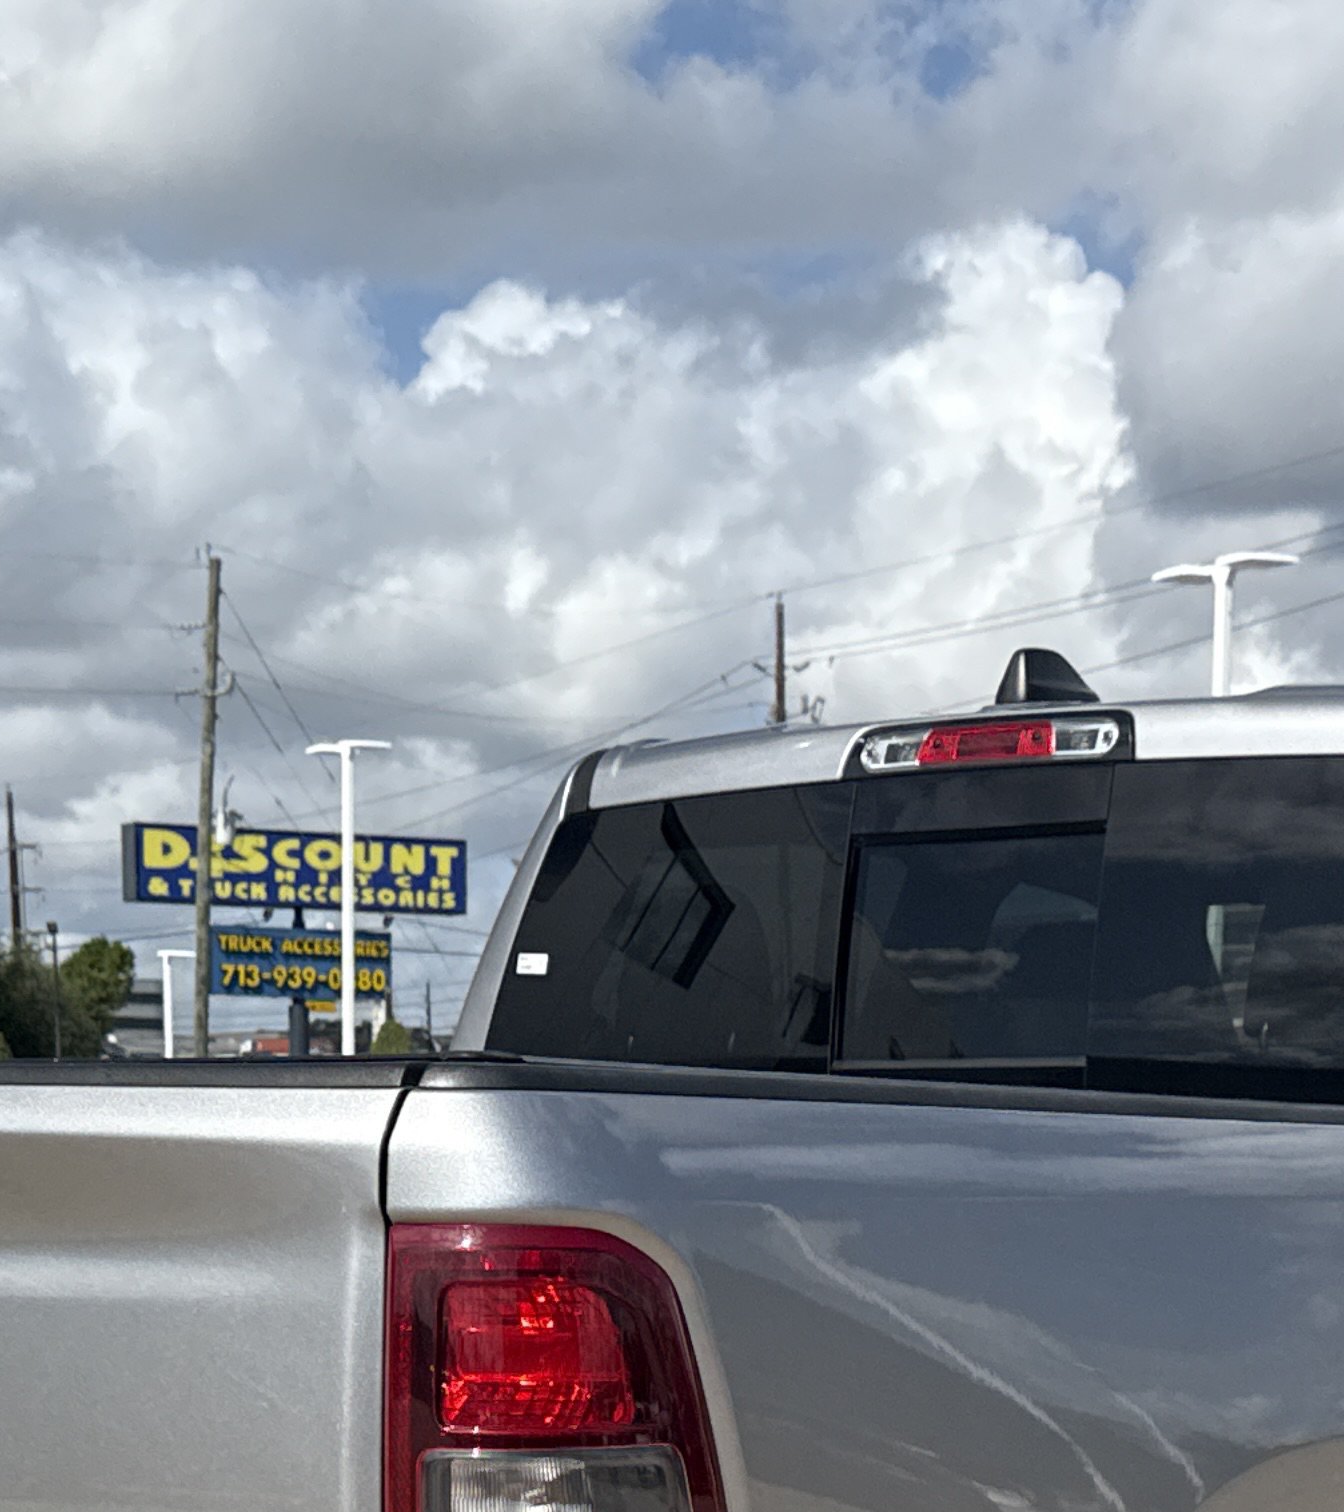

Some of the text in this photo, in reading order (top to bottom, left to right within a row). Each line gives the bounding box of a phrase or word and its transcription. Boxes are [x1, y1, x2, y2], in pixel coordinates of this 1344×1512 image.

[147, 876, 456, 910] & TUCK ACCESORIES
[218, 934, 389, 958] TRUCK ACCESSRIES
[221, 964, 386, 992] 713-939-080
